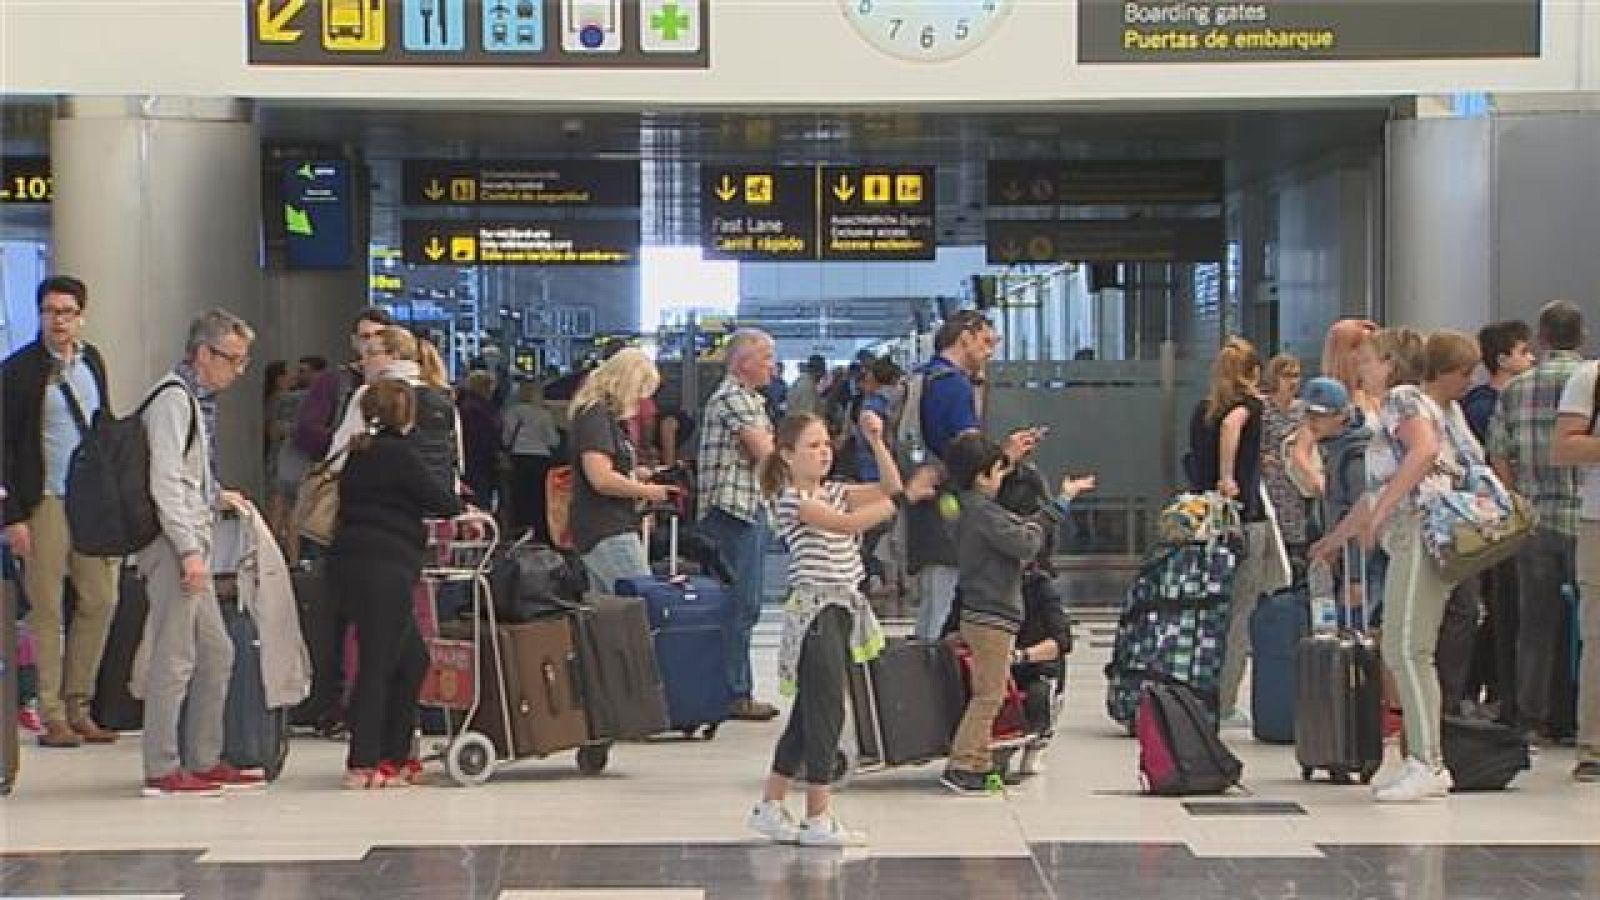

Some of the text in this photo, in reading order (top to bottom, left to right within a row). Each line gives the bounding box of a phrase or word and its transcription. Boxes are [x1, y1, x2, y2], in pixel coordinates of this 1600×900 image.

[1124, 2, 1266, 25] Boarding gates
[890, 18, 903, 40] 7
[920, 25, 934, 48] 6
[955, 18, 970, 40] 5
[1124, 28, 1333, 50] Puertas de embarque
[712, 217, 784, 233] Fast Lane
[712, 236, 754, 250] Carril
